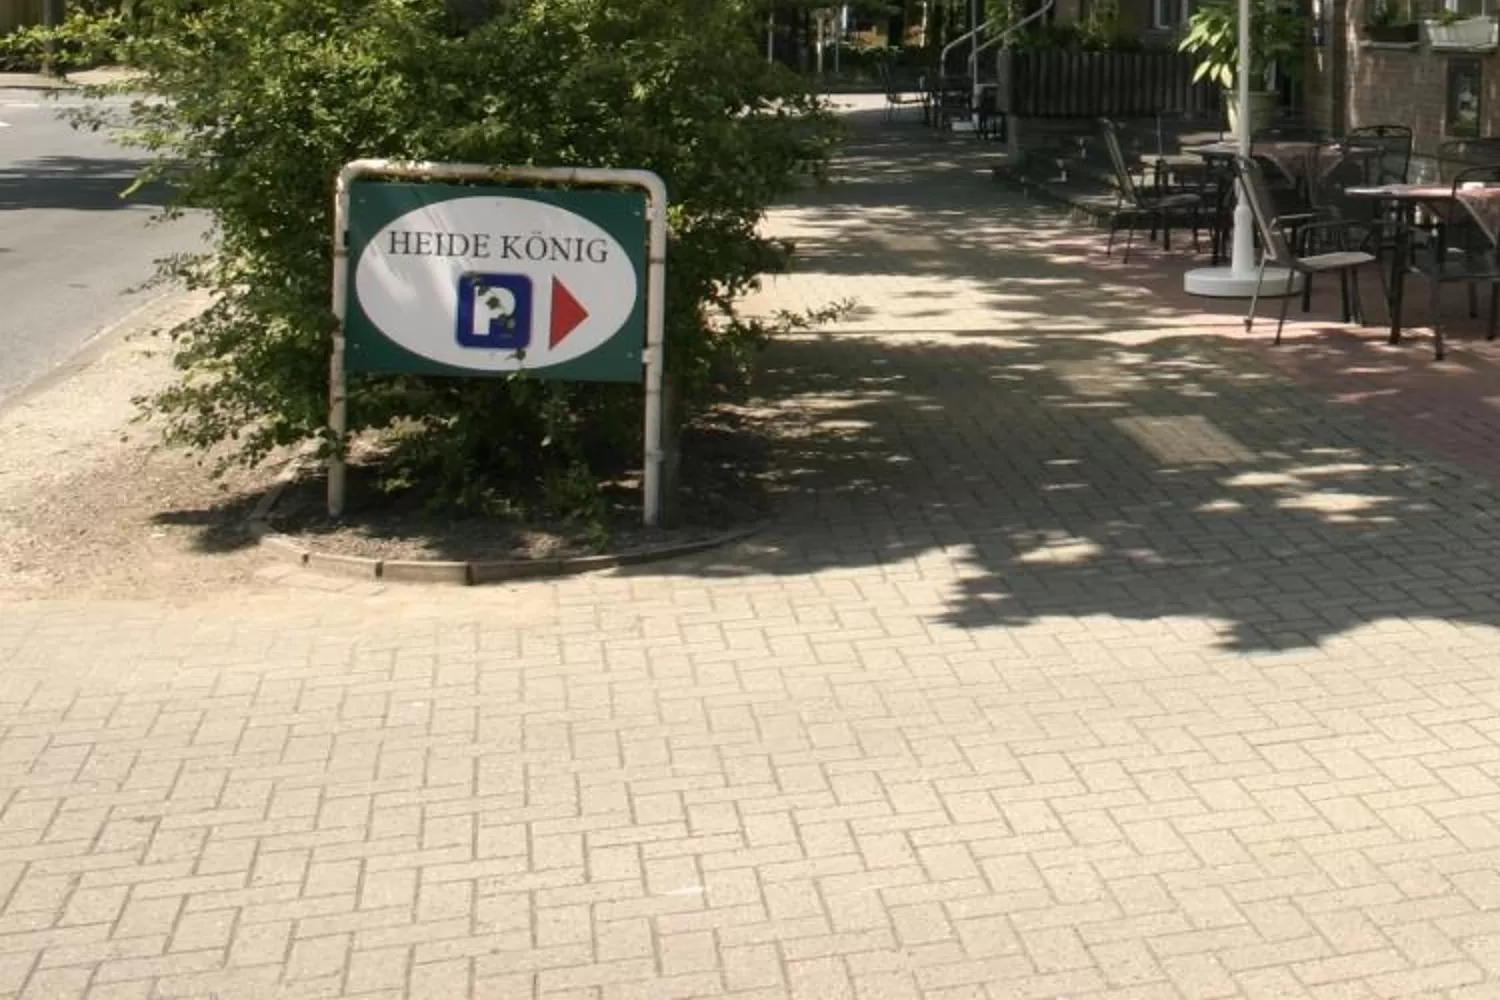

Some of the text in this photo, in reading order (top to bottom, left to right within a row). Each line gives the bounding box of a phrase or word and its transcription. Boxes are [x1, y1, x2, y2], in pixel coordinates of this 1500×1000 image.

[387, 230, 609, 263] HEIDE KÖNIG
[472, 286, 517, 336] P
